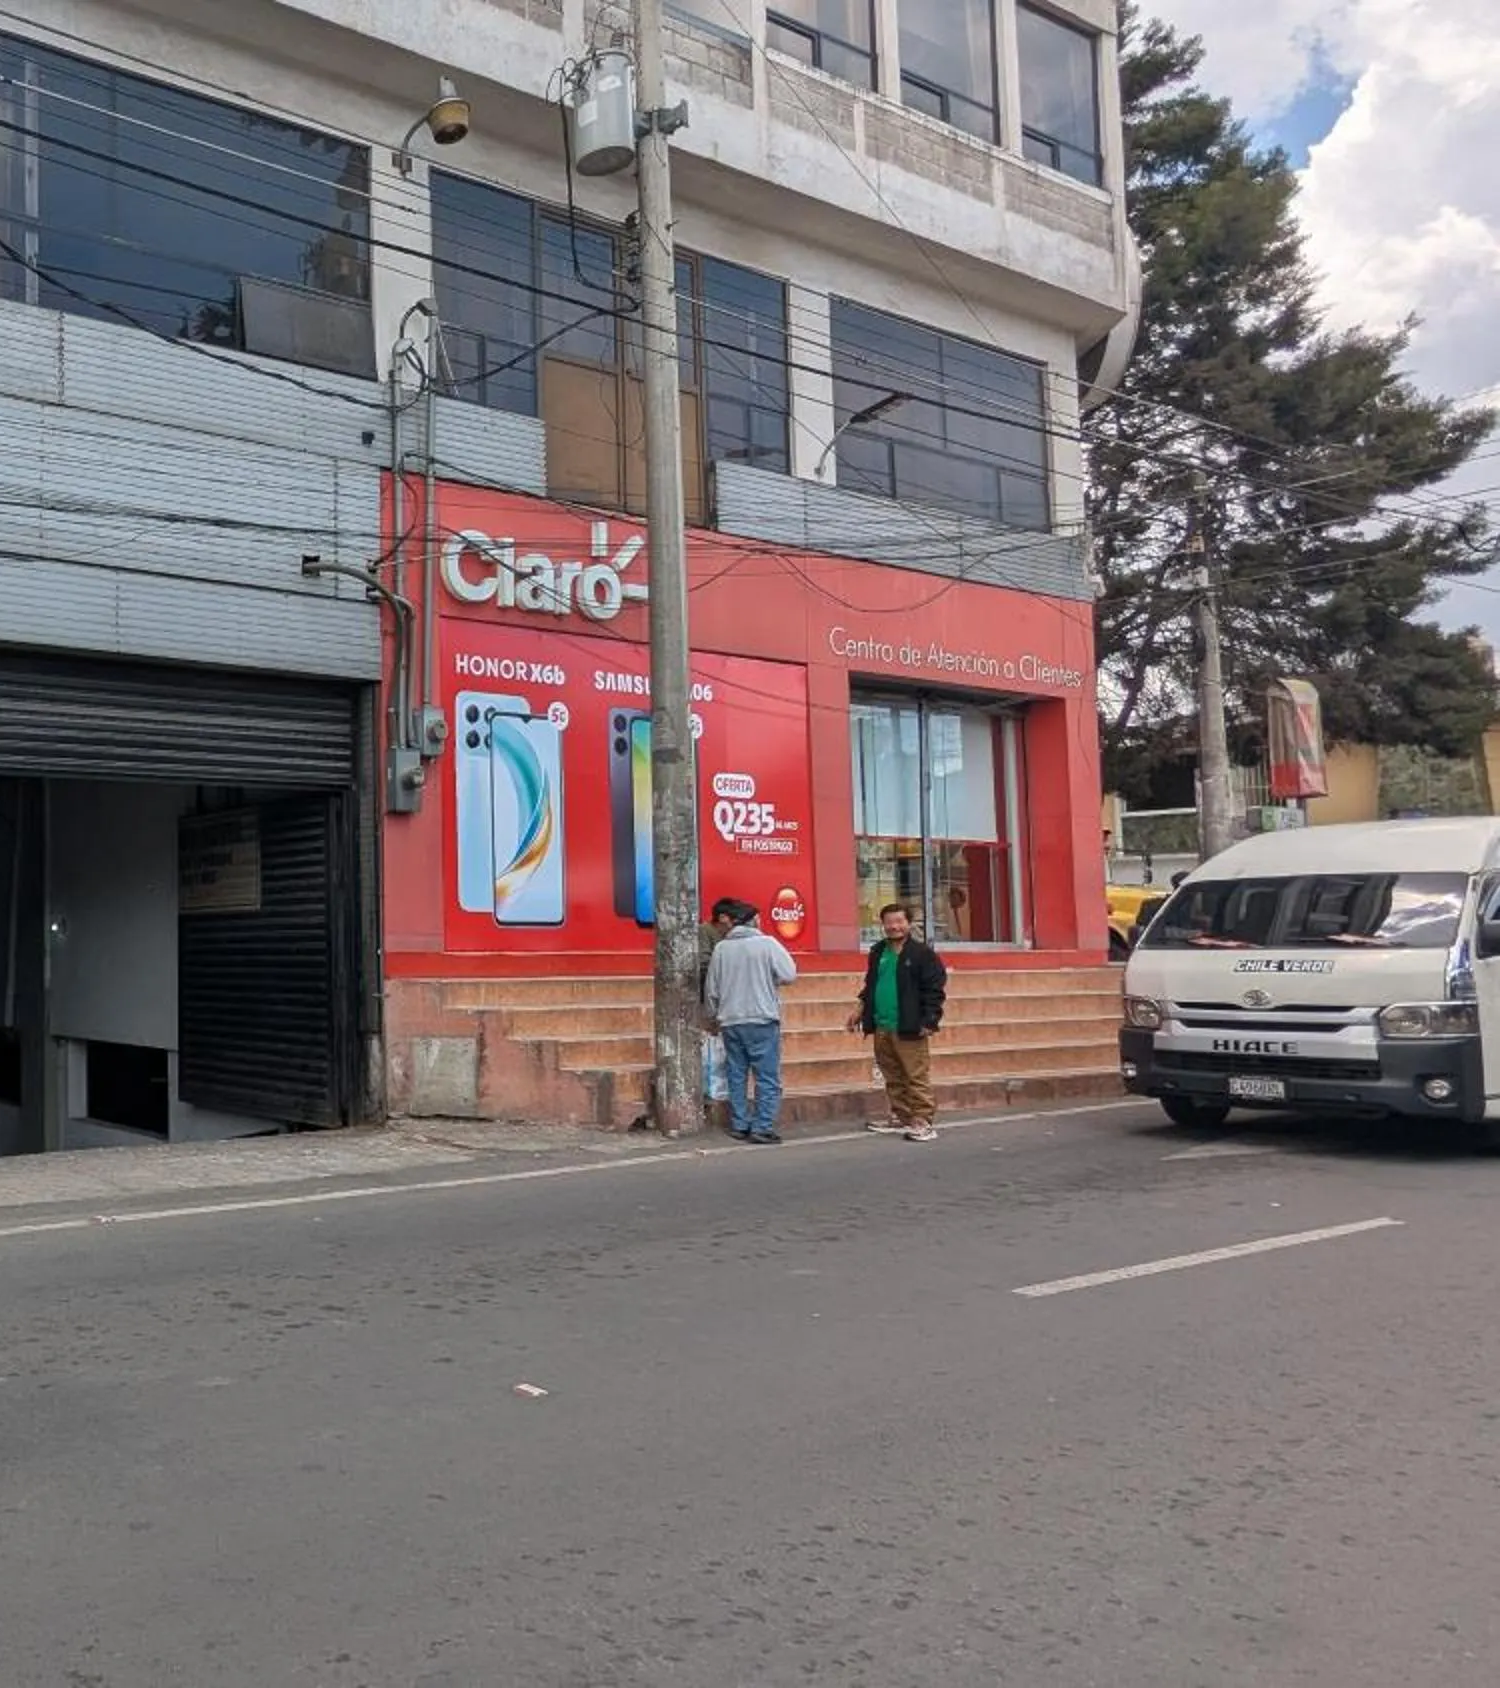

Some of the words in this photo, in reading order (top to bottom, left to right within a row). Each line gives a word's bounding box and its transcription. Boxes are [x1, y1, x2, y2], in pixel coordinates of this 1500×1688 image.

[440, 528, 622, 620] Claro
[829, 627, 893, 663] Centro
[900, 641, 921, 667] de
[927, 643, 999, 677] Atención
[1003, 661, 1015, 680] a
[1019, 655, 1082, 689] Clientes
[455, 654, 529, 681] HONOR
[529, 665, 565, 686] X6b
[688, 683, 713, 702] 06
[715, 777, 752, 793] OFERTA
[713, 800, 775, 841] Q235
[771, 905, 800, 921] Claro
[1236, 959, 1279, 972] CHILE
[1213, 1039, 1298, 1055] HIACE
